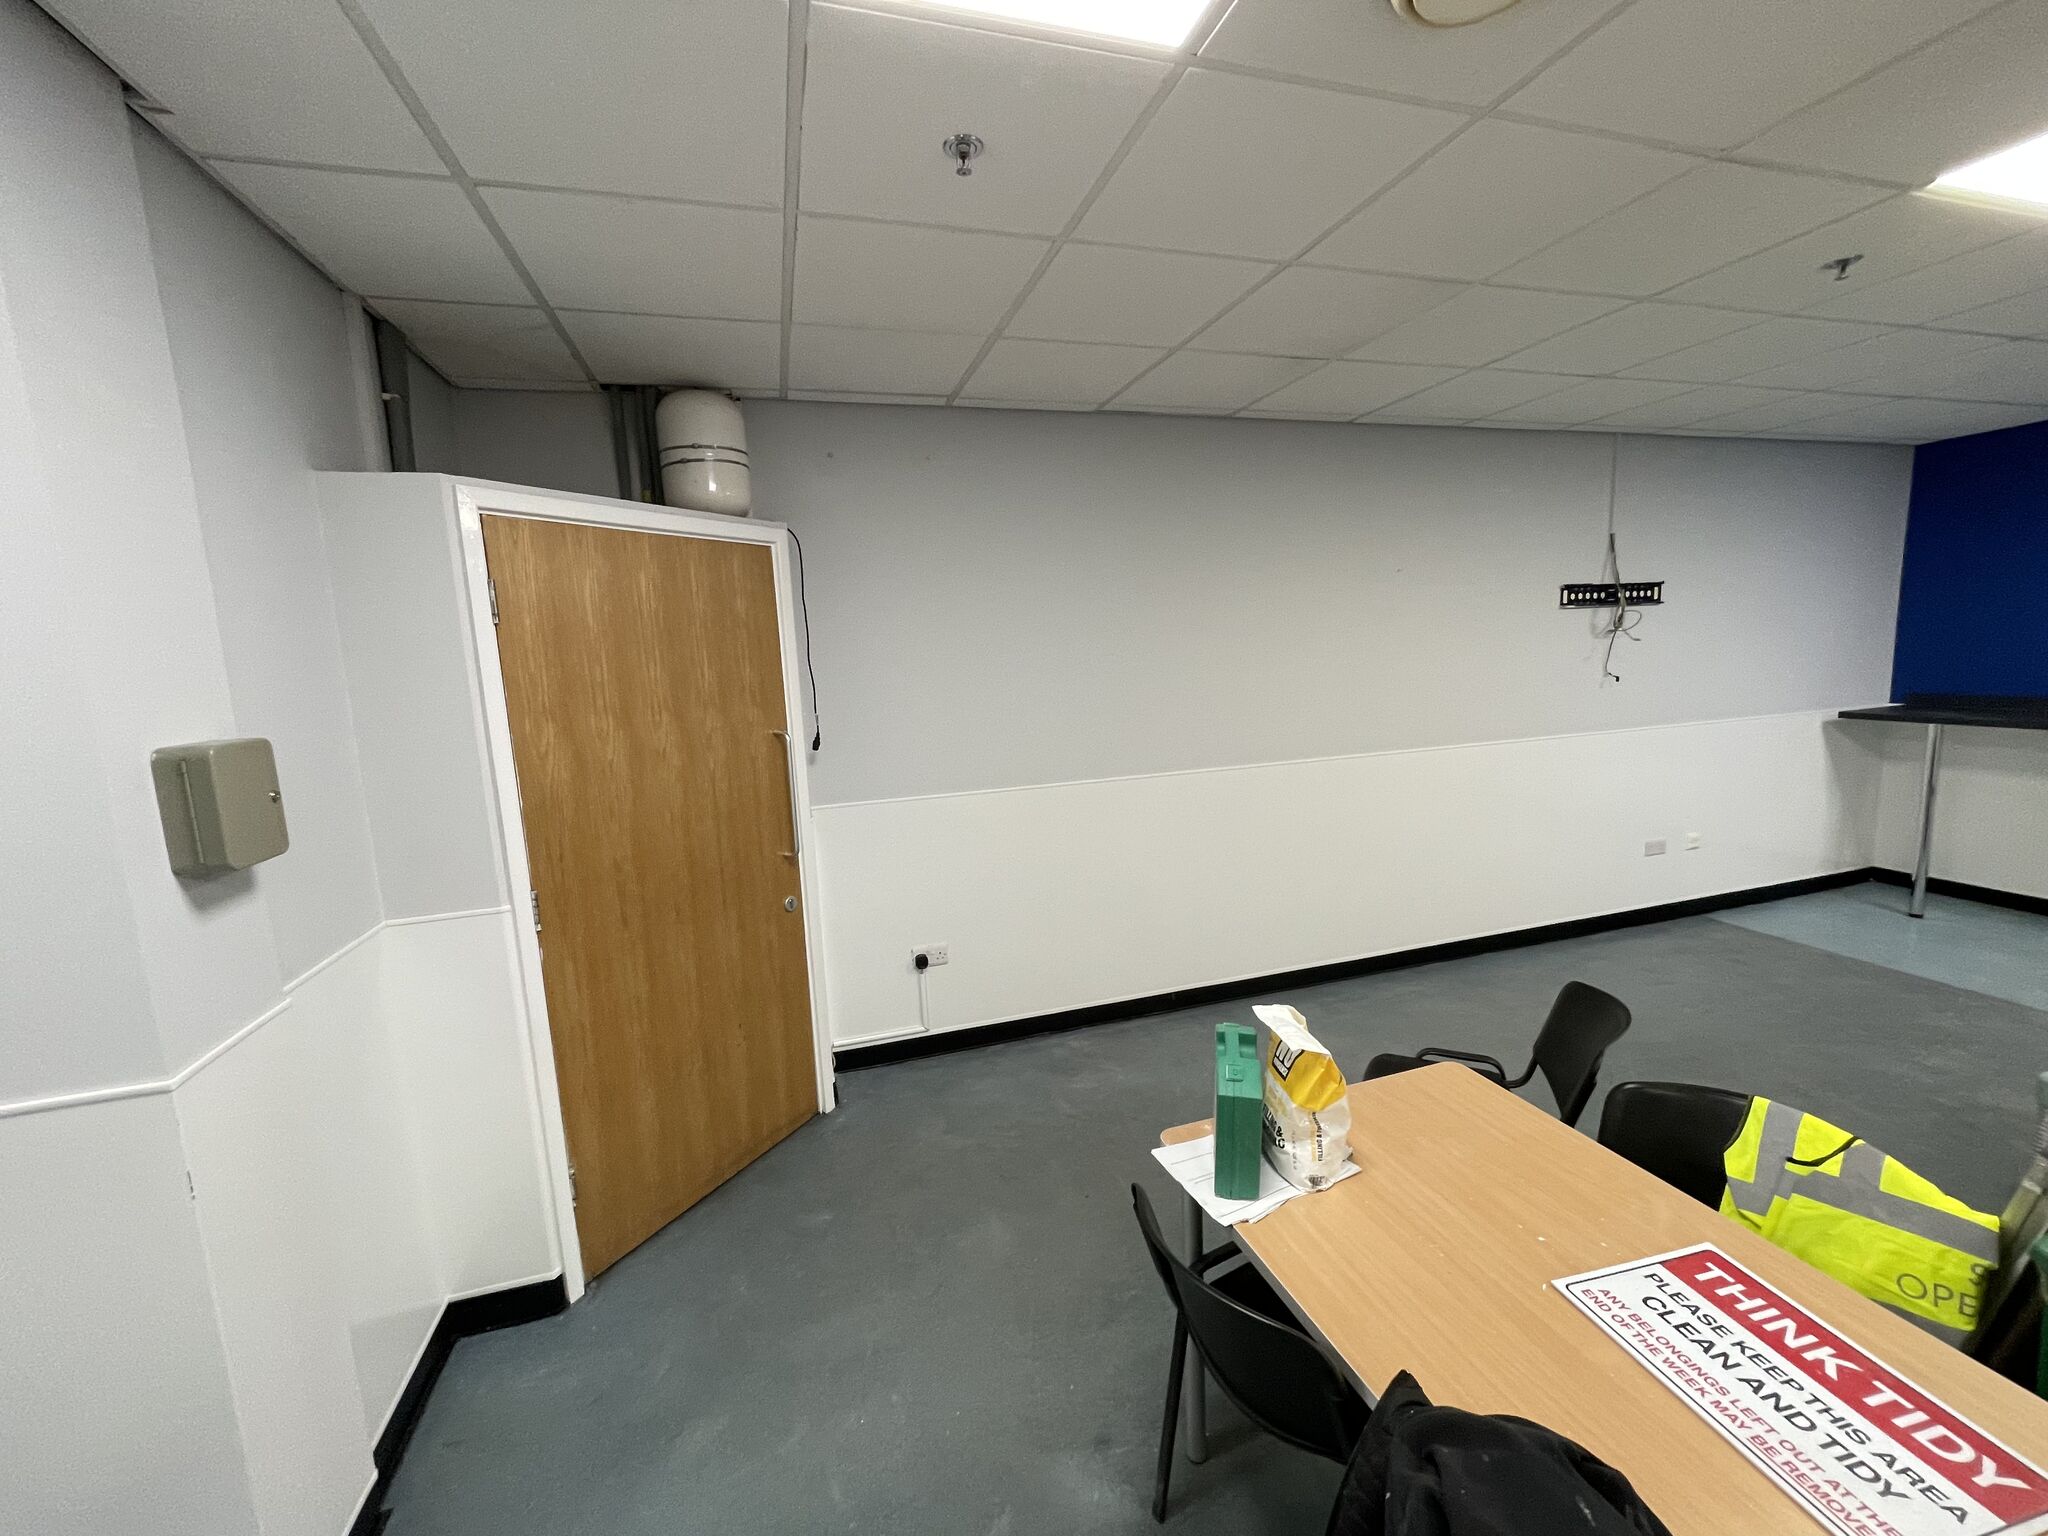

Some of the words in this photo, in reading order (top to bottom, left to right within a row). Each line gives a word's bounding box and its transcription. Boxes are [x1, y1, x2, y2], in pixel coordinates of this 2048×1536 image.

[1581, 1288, 1611, 1312] END
[1611, 1314, 1635, 1332] OF
[1630, 1329, 1664, 1357] THE
[1662, 1357, 1712, 1398] WEEK
[1710, 1400, 1752, 1430] MAY
[1750, 1435, 1782, 1458] BE
[1598, 1288, 1631, 1311] ANY
[1628, 1313, 1731, 1397] BELONGINGS
[1730, 1399, 1780, 1435] LEFT
[1778, 1439, 1826, 1473] OUT
[1822, 1479, 1858, 1499] AT
[1642, 1296, 1742, 1370] CLEAN
[1735, 1378, 1817, 1432] AND
[1818, 1433, 1912, 1499] TIDY
[1644, 1273, 1734, 1338] PLEASE
[1730, 1341, 1804, 1391] KEEP
[1805, 1393, 1872, 1445] THIS
[1870, 1452, 1968, 1524] AREA
[1694, 1262, 1864, 1381] THINK
[1862, 1380, 2033, 1490] TIDY
